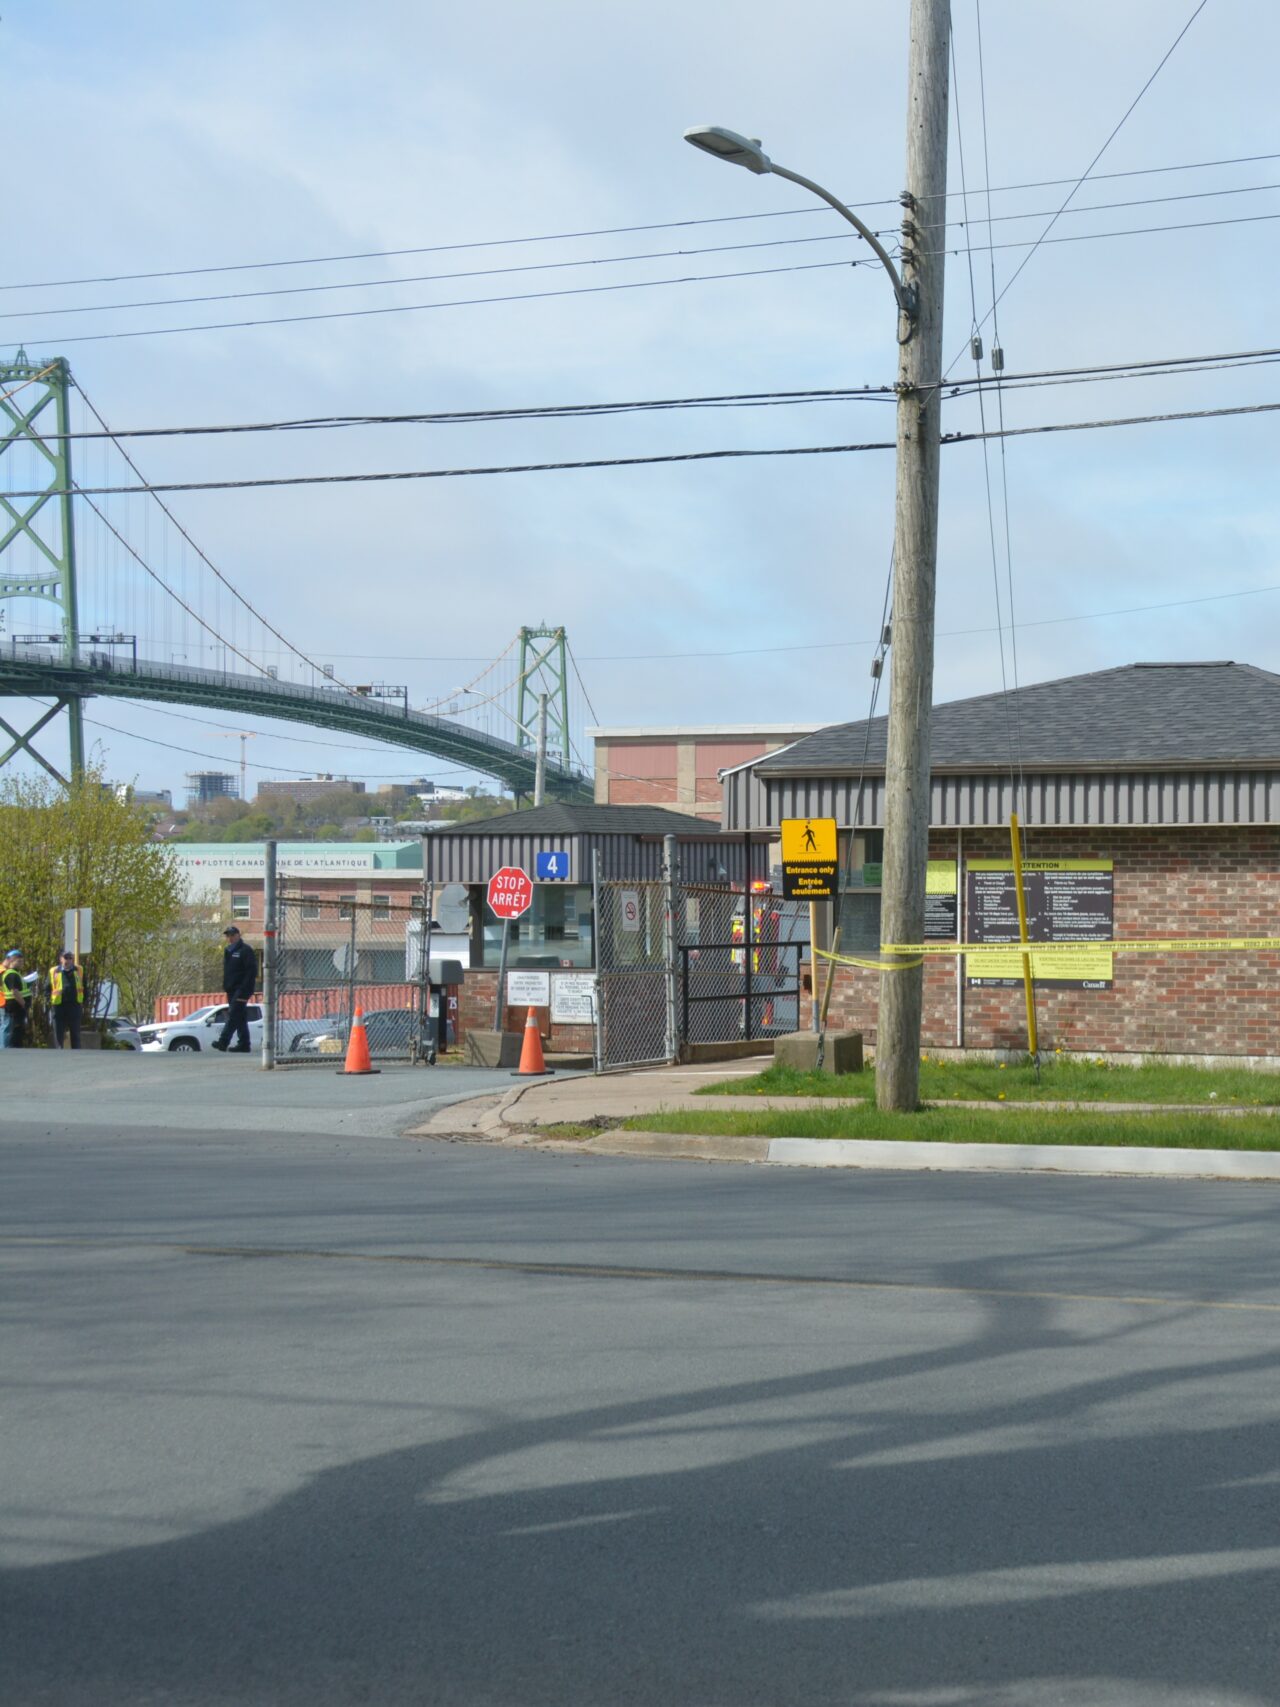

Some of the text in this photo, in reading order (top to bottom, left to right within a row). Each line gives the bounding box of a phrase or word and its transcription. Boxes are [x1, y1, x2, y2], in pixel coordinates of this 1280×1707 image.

[547, 855, 558, 874] 4
[786, 866, 834, 875] Entrance only
[496, 876, 525, 890] STOP
[798, 878, 823, 886] Entrée
[491, 892, 527, 908] ARRÊT
